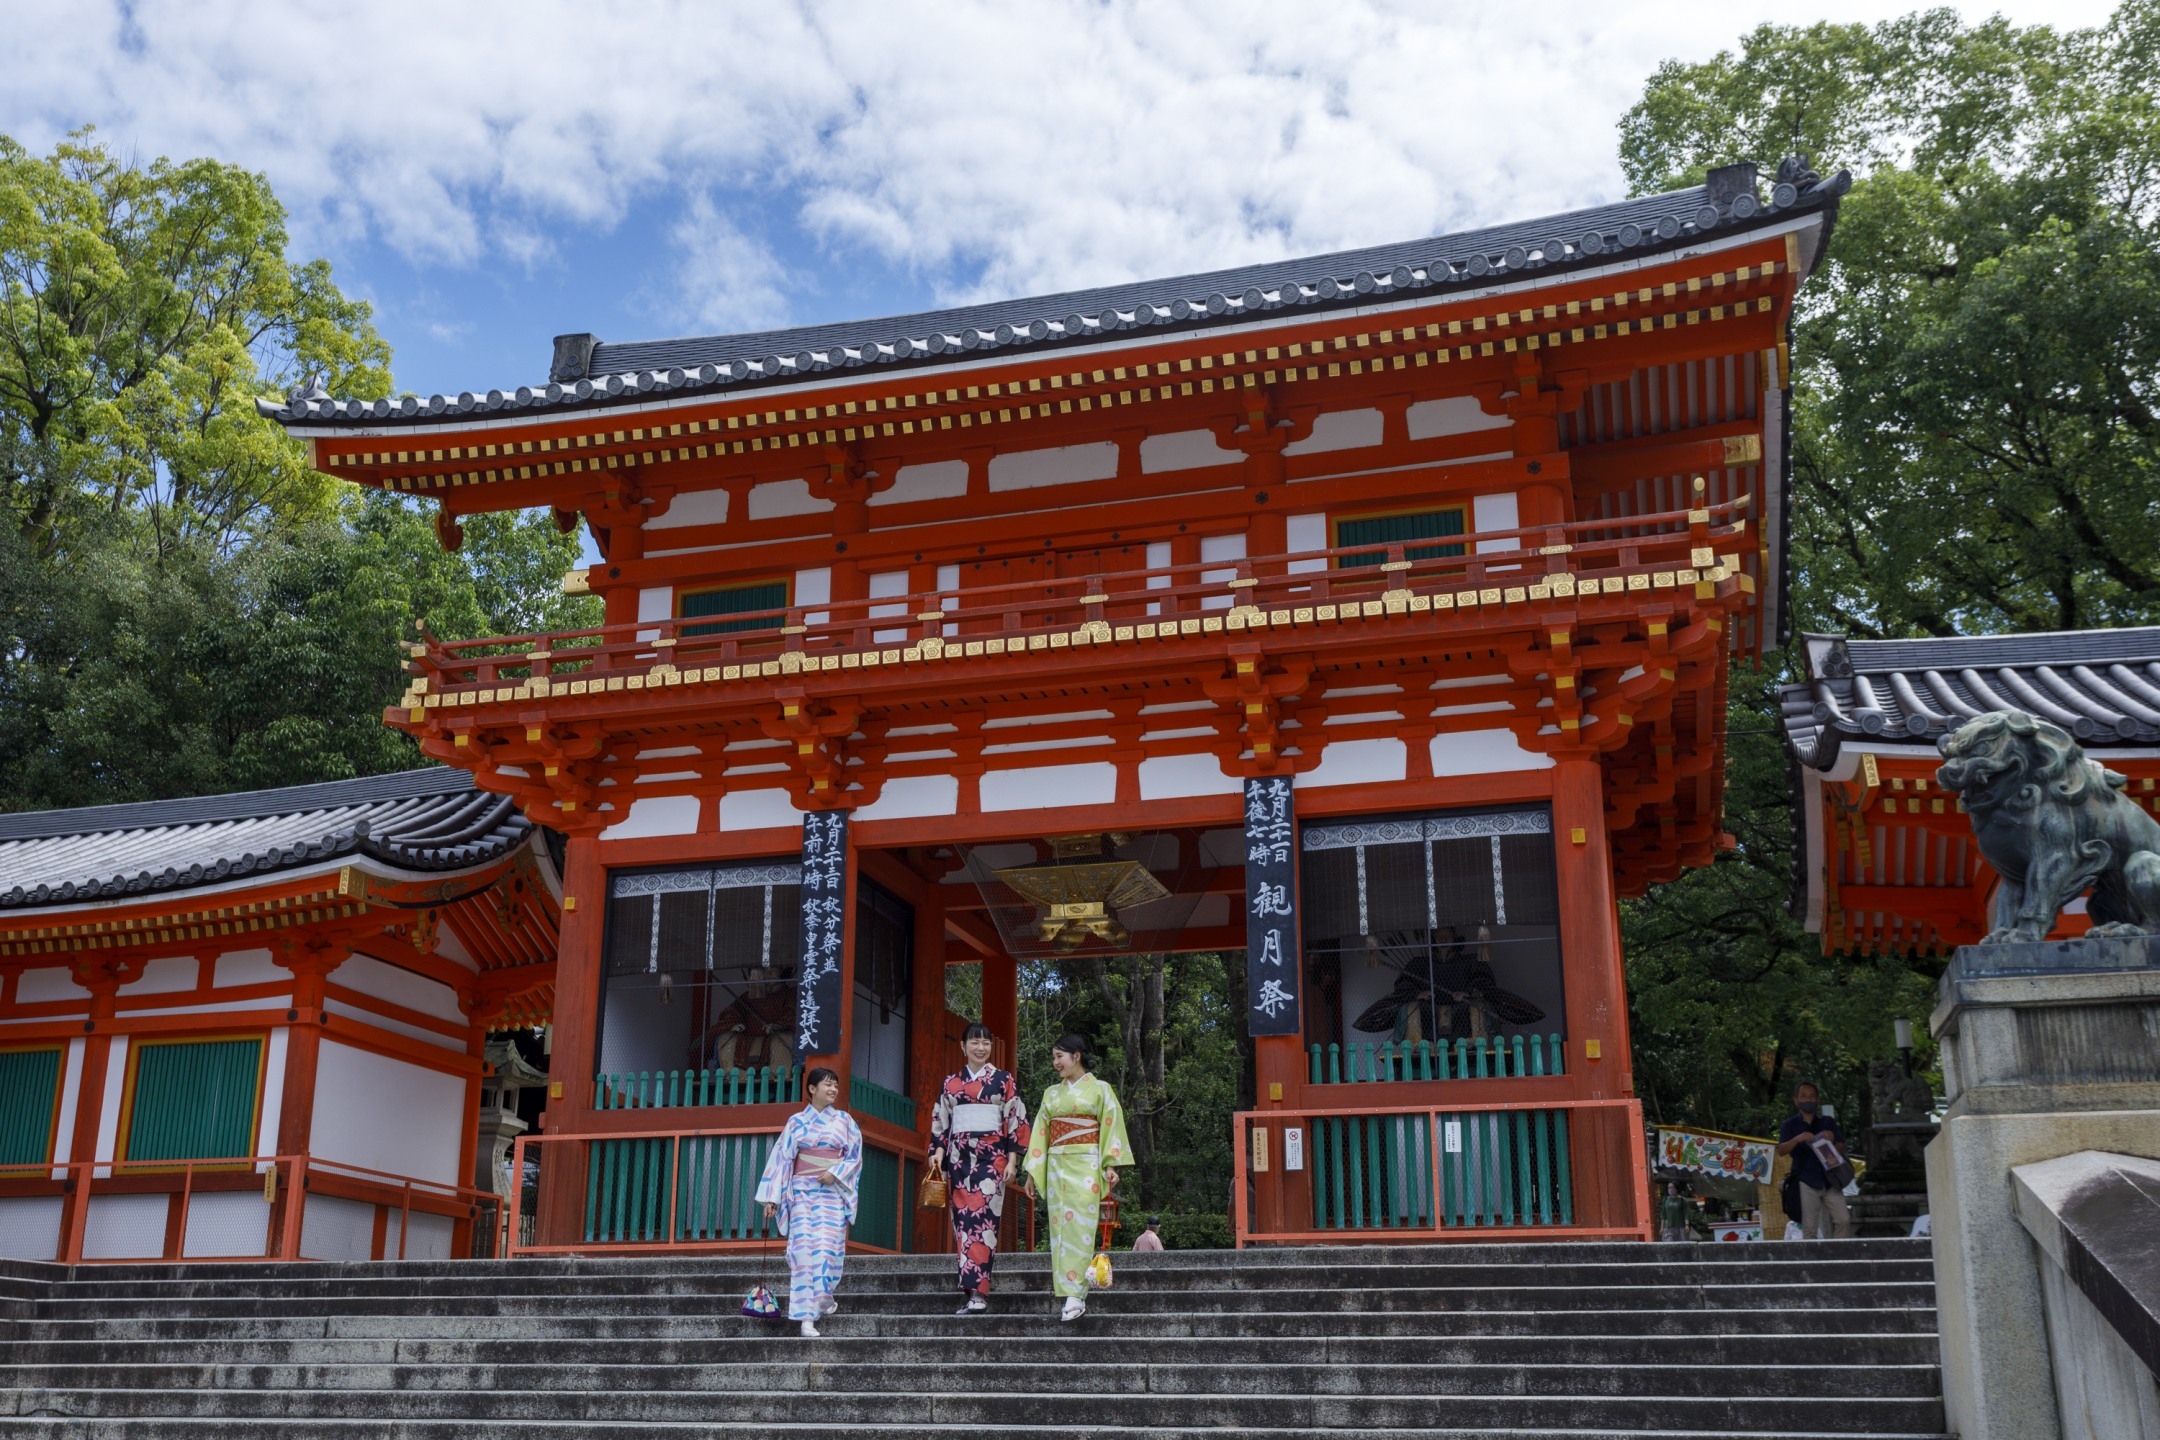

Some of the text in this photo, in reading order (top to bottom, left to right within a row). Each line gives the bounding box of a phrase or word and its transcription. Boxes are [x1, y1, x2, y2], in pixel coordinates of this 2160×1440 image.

[803, 814, 823, 891] 午前十時
[1245, 780, 1271, 867] 午後七時
[1267, 779, 1291, 862] 九月二十一日
[819, 813, 843, 974] 九月二十三日 秋分祭並
[1250, 881, 1294, 1019] 観月祭
[1665, 1136, 1769, 1178] りんごあめ
